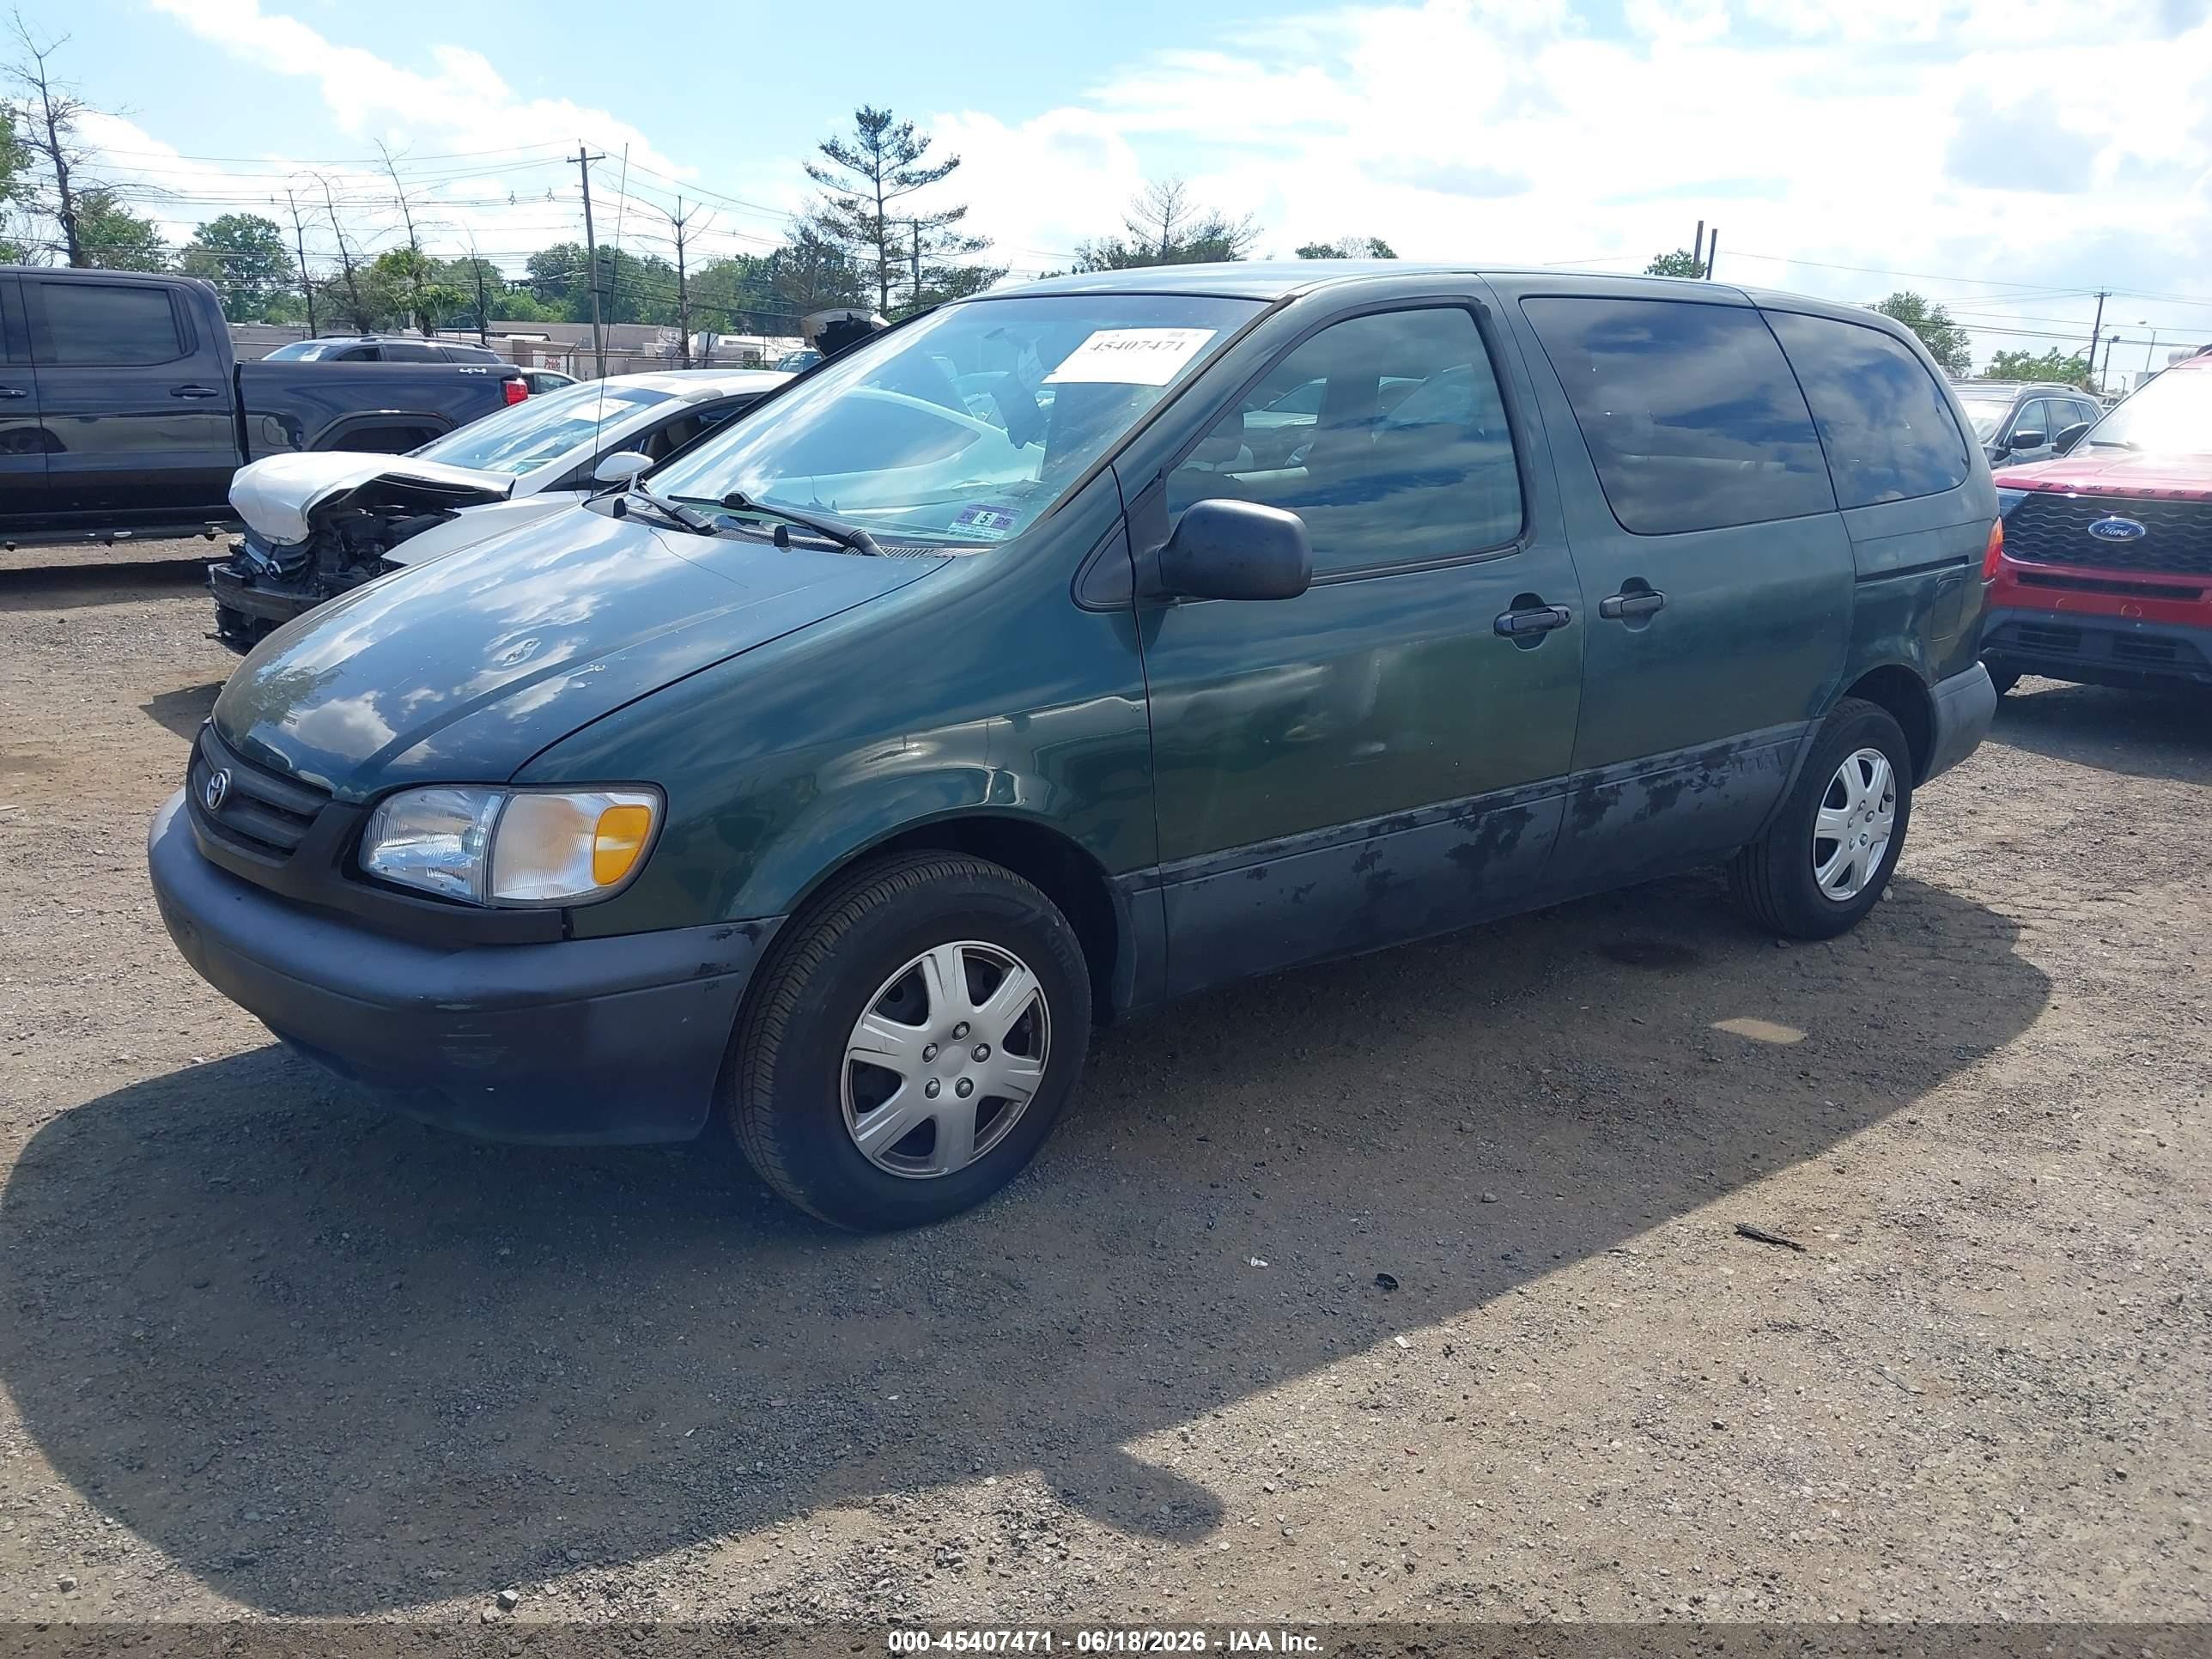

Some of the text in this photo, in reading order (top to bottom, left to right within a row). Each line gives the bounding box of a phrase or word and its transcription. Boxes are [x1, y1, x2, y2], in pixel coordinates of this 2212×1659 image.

[1090, 341, 1186, 350] 45407471
[979, 513, 992, 523] 5
[2100, 523, 2131, 537] Ford
